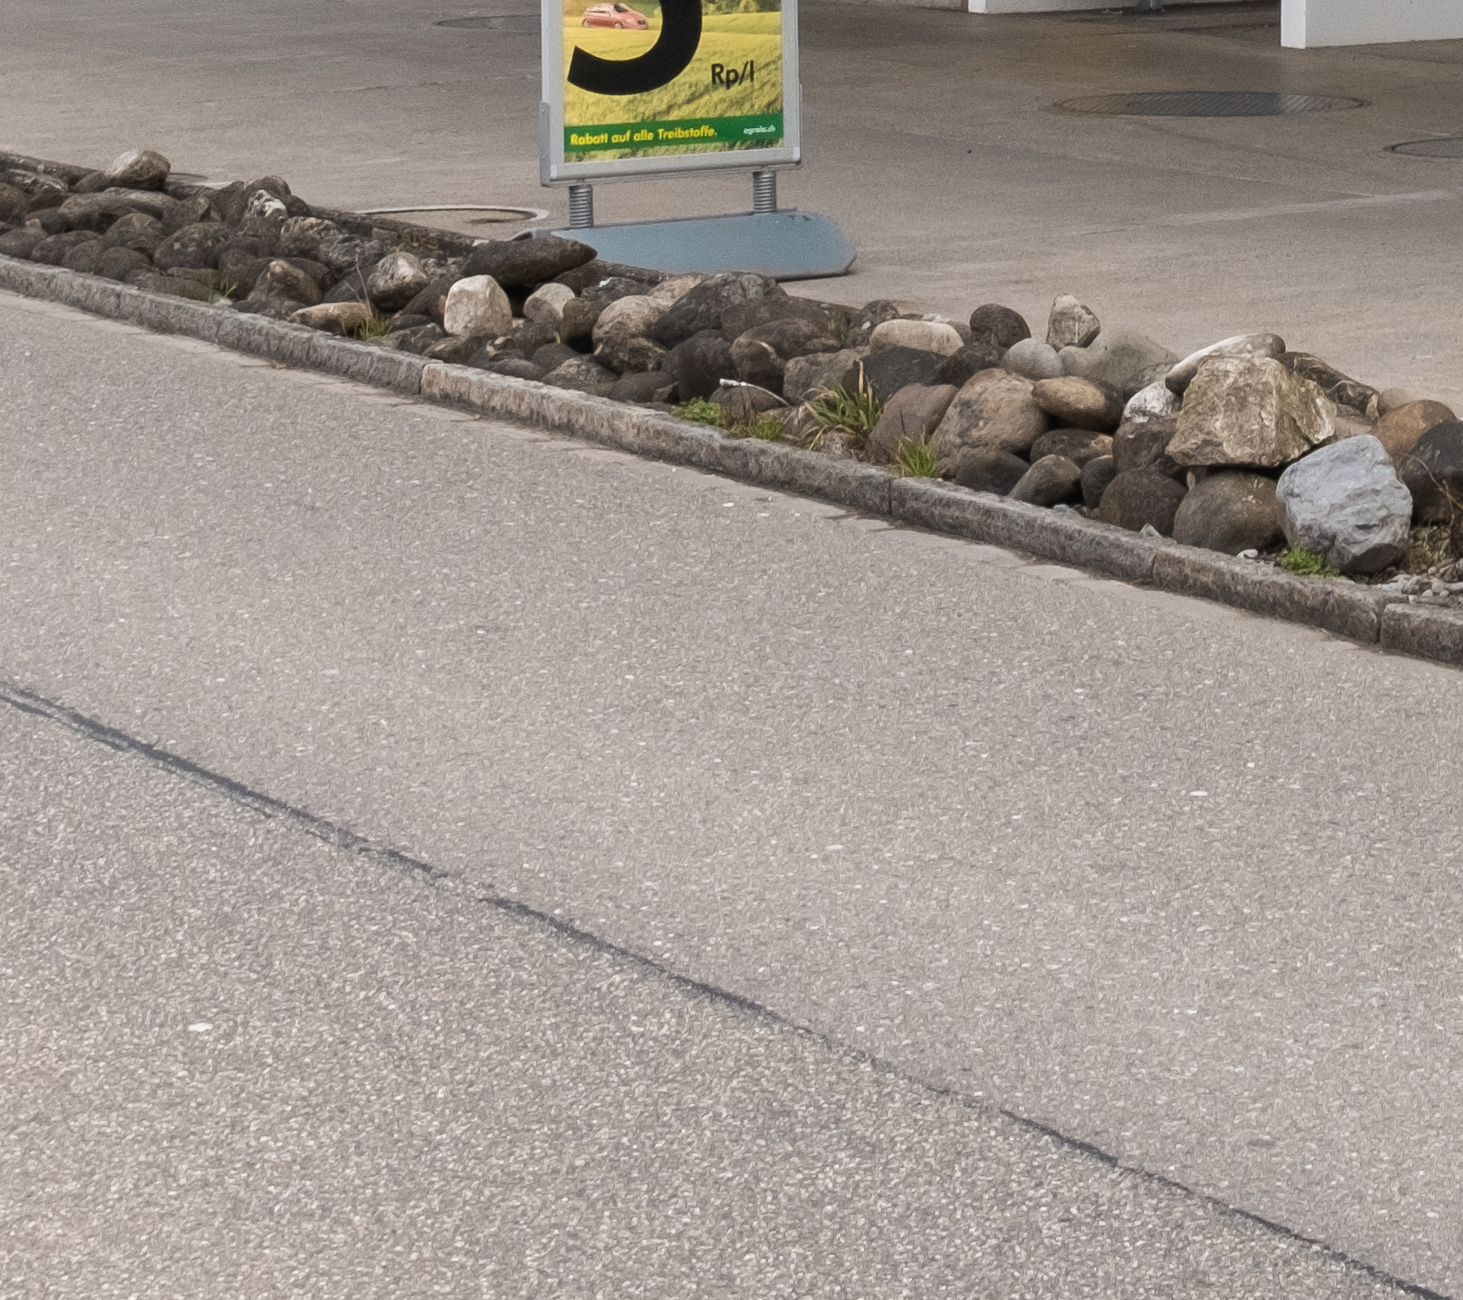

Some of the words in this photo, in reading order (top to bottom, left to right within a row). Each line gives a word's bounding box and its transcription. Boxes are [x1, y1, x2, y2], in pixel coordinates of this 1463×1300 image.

[711, 60, 755, 90] Rp/l
[570, 132, 608, 146] Rabatt
[611, 130, 631, 143] auf
[633, 129, 654, 142] alle
